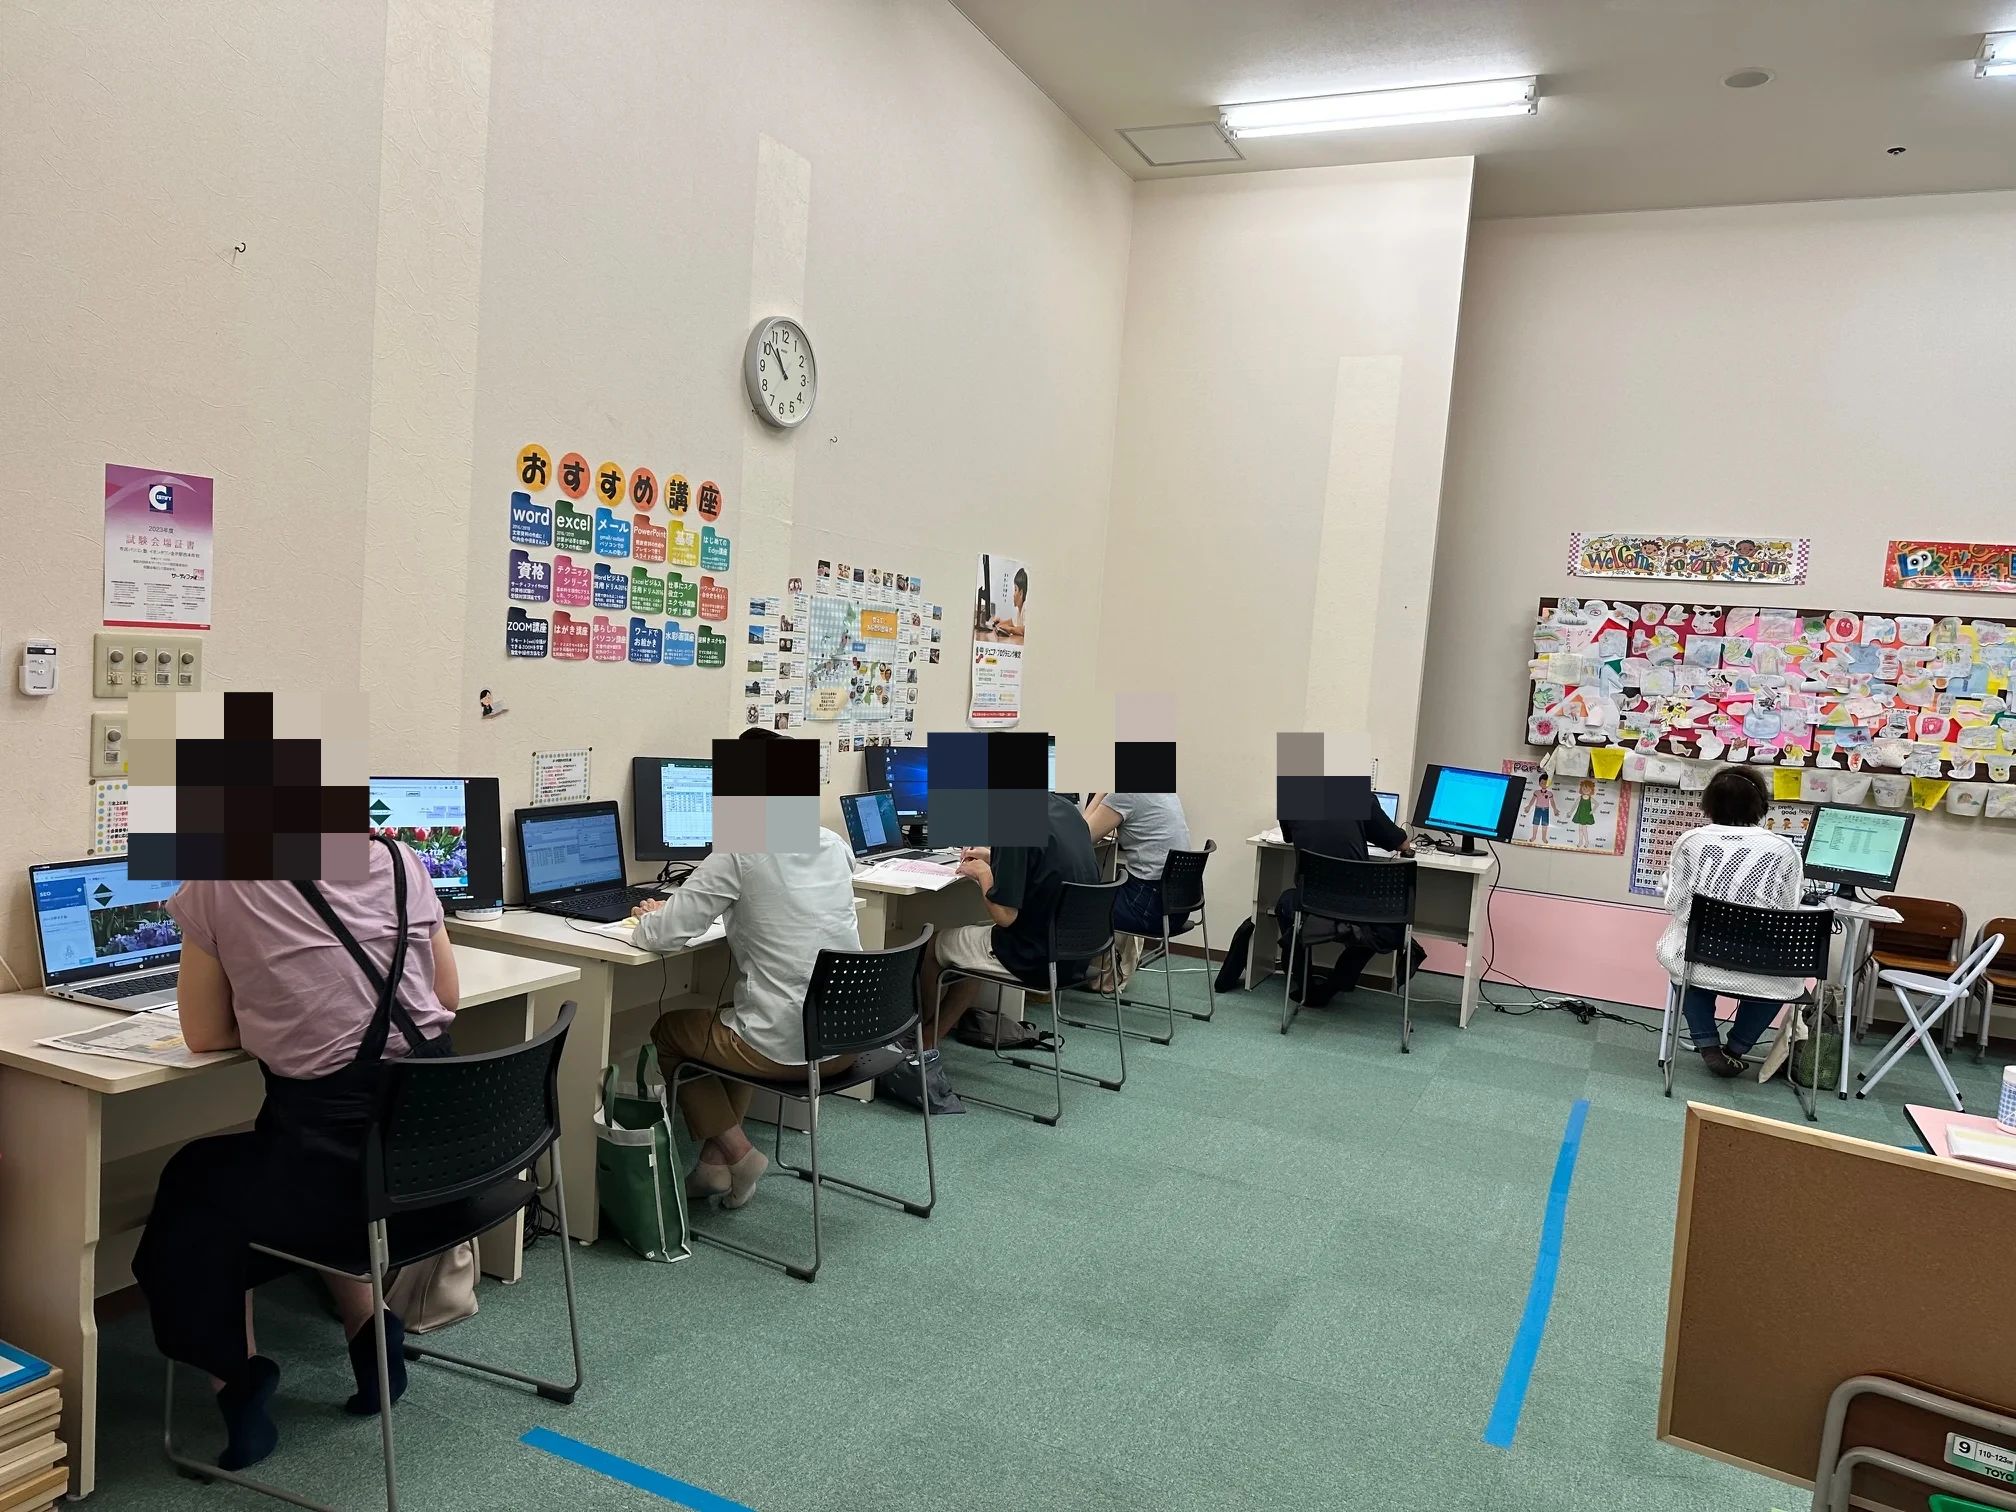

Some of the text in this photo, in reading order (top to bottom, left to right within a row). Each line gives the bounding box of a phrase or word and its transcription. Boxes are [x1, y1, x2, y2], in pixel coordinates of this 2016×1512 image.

[772, 330, 778, 345] 11
[782, 329, 789, 344] 12
[763, 341, 771, 356] 10
[794, 340, 797, 352] 1
[760, 359, 766, 372] 9
[799, 355, 804, 368] 2
[762, 379, 768, 392] 8
[800, 374, 806, 387] 3
[770, 394, 775, 406] 7
[796, 392, 802, 405] 4
[779, 402, 784, 415] 6
[789, 401, 795, 413] 5
[522, 452, 720, 517] おすすめ講座
[513, 508, 550, 526] word
[557, 515, 591, 532] excel
[149, 526, 174, 534] 2023年度
[598, 519, 629, 533] メール
[633, 526, 667, 538] PowerPoint
[126, 534, 195, 550] 試験会場証書
[703, 535, 727, 547] はじめての
[517, 561, 545, 580] 資格
[557, 565, 588, 577] テクニック
[1666, 558, 1685, 572] to
[1732, 556, 1787, 575] Room
[563, 577, 588, 587] シリーズ
[507, 621, 548, 634] ZOOM講座
[554, 624, 589, 636] はがき講座
[635, 627, 659, 637] ワードで
[634, 638, 657, 648] お絵かき
[1959, 1441, 1971, 1454] 9
[1984, 1467, 2015, 1482] TOYO
